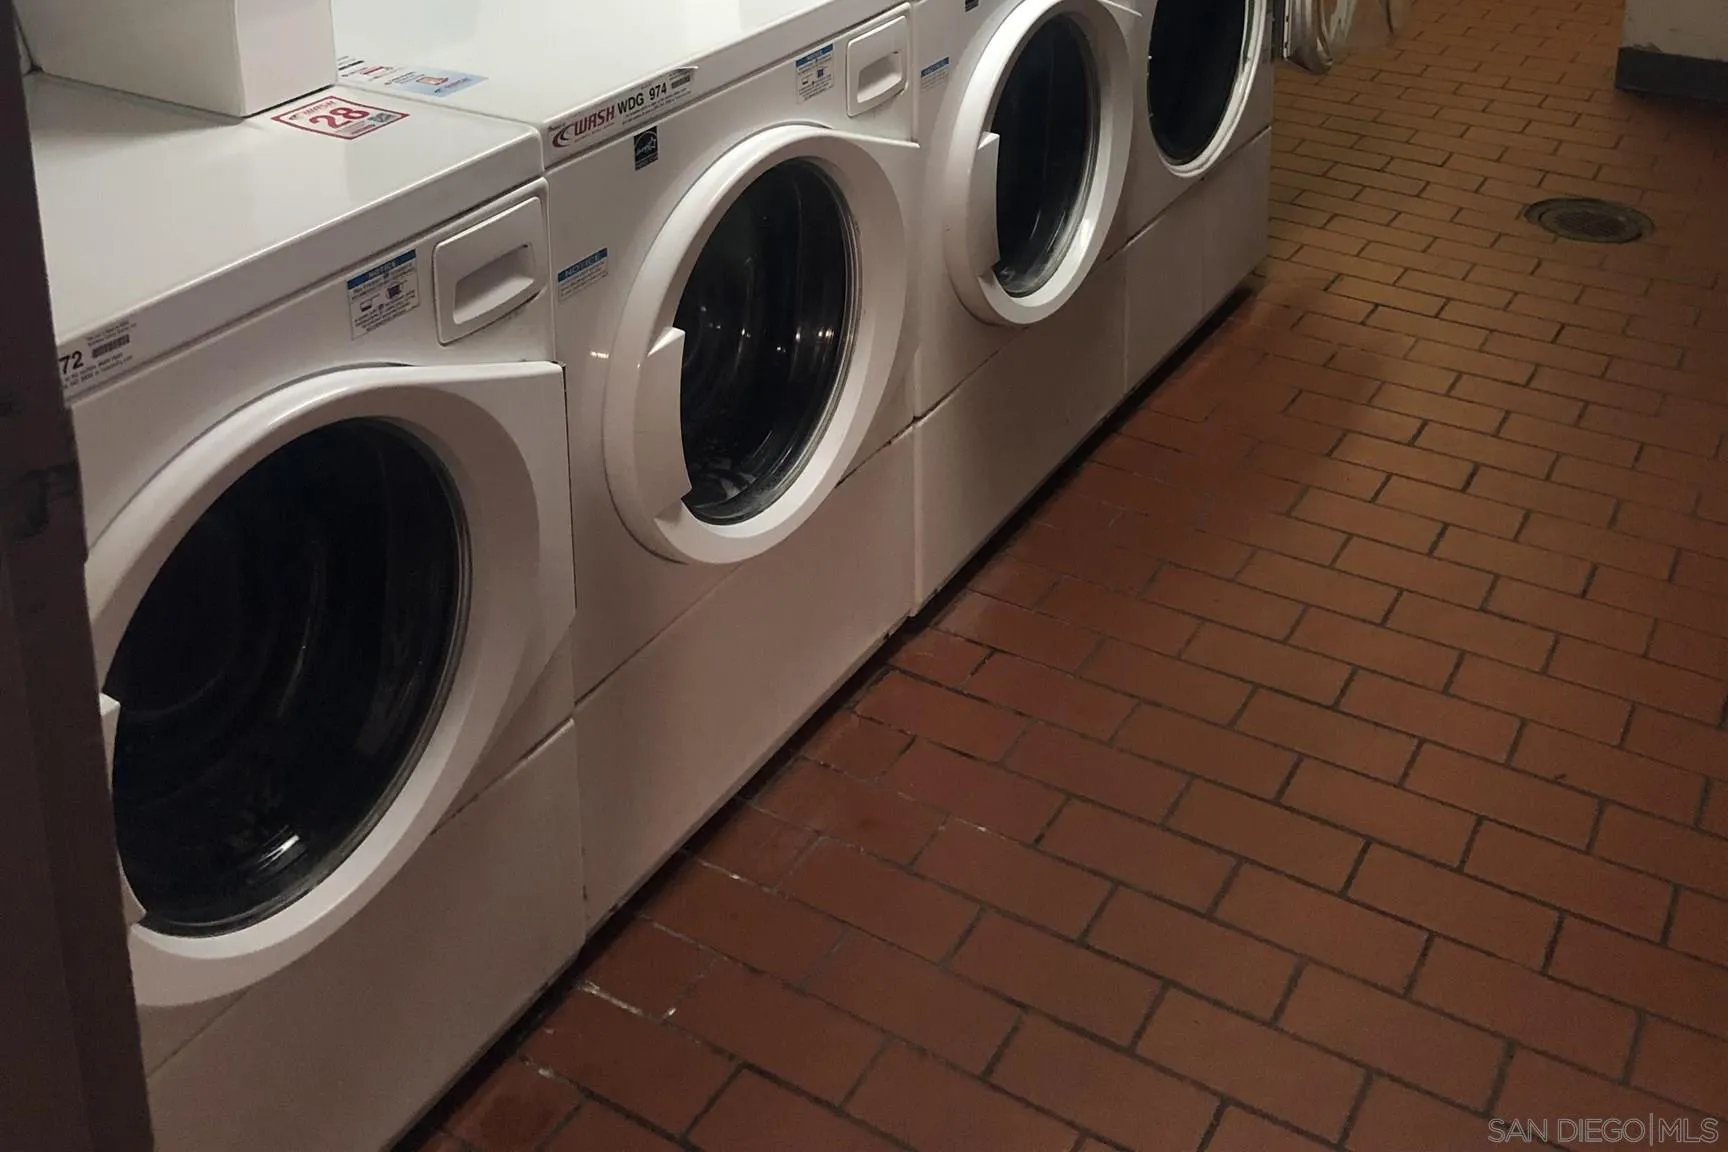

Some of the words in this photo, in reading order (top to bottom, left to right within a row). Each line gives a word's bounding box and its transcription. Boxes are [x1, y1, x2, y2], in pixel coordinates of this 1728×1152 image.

[308, 107, 370, 129] 28
[573, 105, 615, 136] WASH
[617, 93, 645, 115] WDG
[649, 82, 667, 101] 974
[58, 350, 84, 374] 72
